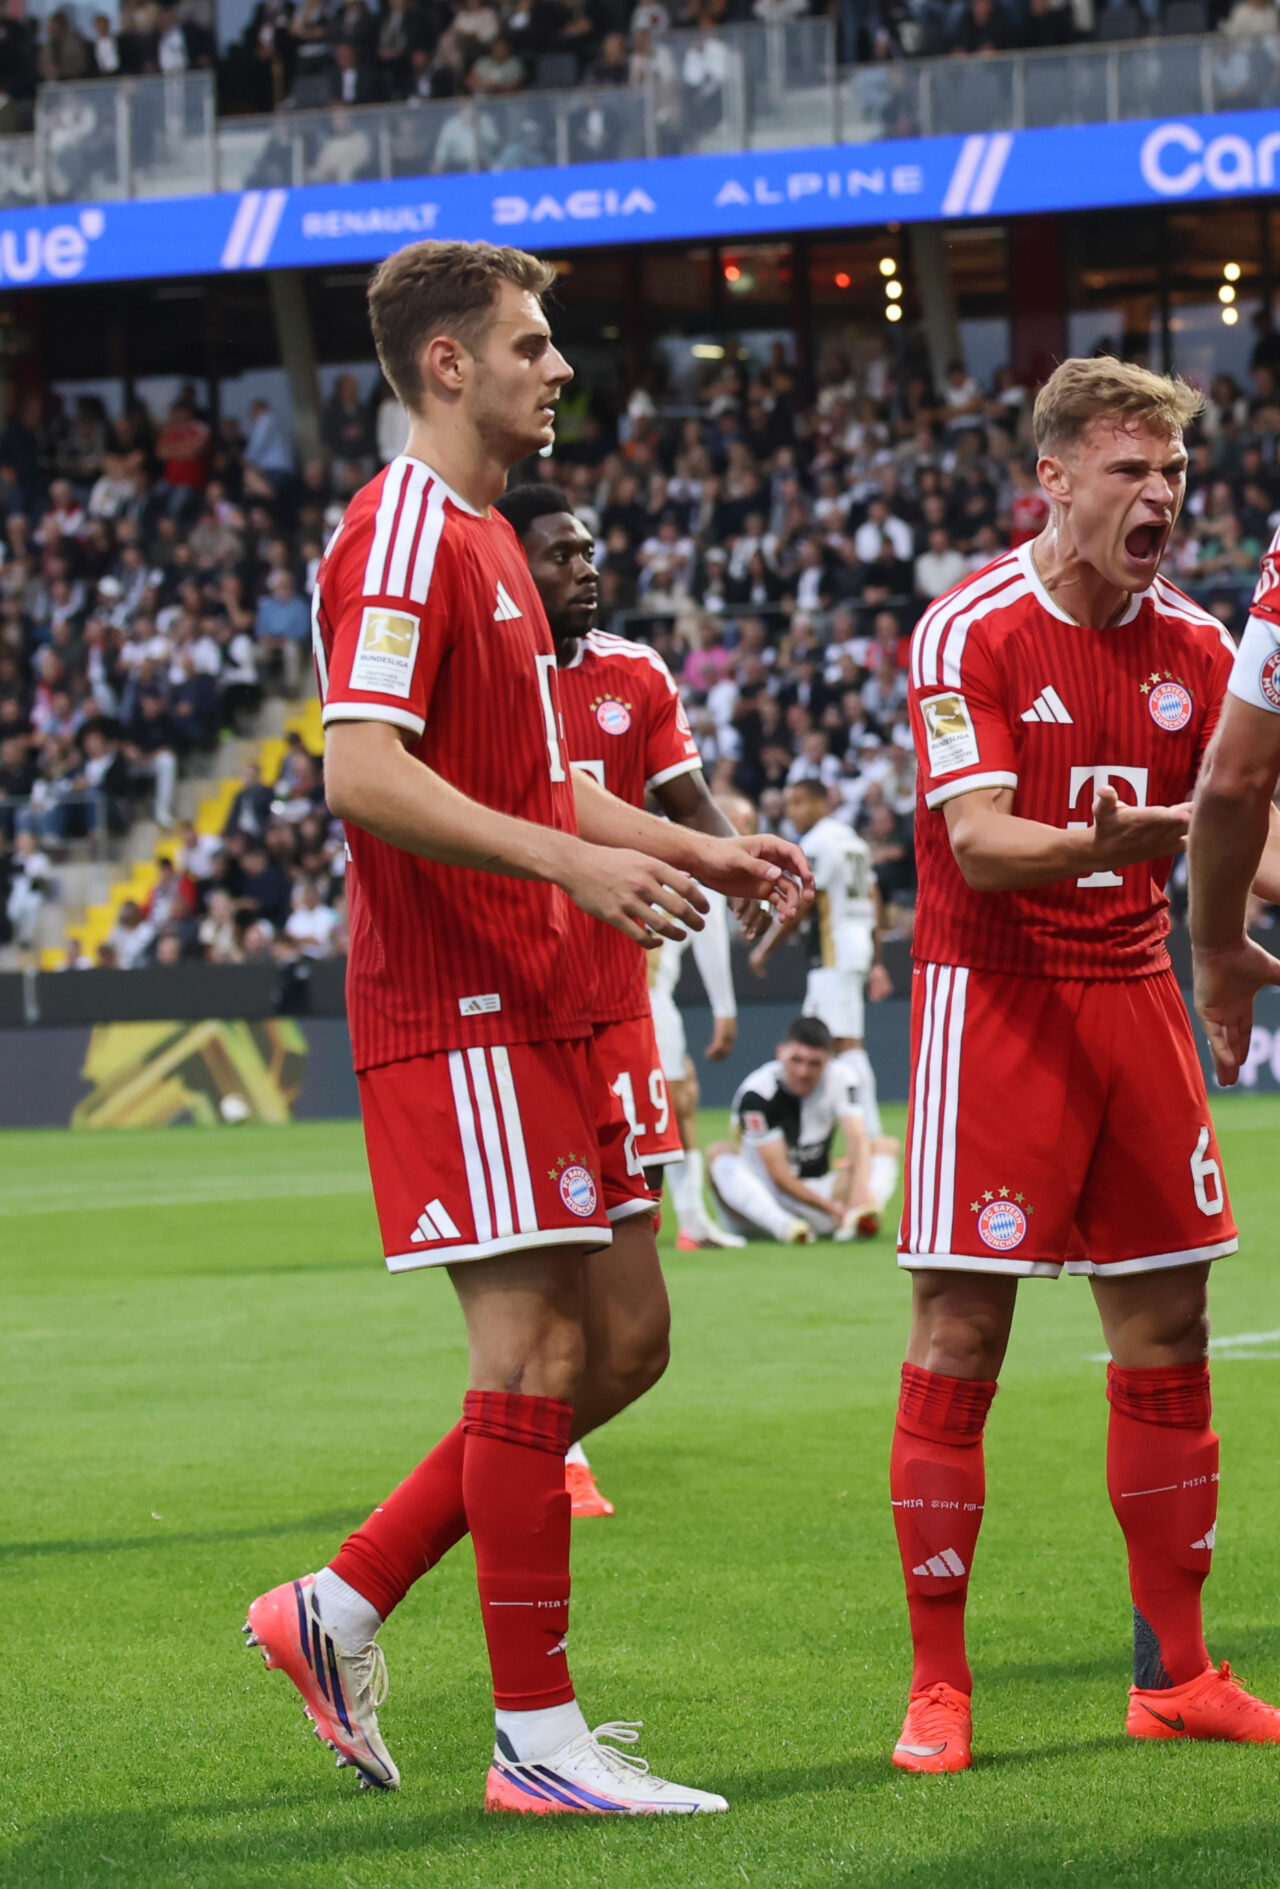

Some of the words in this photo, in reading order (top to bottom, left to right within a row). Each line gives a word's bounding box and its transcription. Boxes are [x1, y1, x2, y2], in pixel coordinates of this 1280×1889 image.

[716, 164, 922, 206] ALPINE
[303, 204, 440, 238] RENAULT
[492, 187, 656, 225] DACIA
[360, 654, 409, 669] BUNDESLIGA
[611, 1068, 671, 1136] 19
[1189, 1126, 1224, 1216] 6
[1182, 1475, 1207, 1489] MIA
[902, 1498, 924, 1509] MIA
[930, 1499, 959, 1510] SAN
[537, 1600, 561, 1609] MIA
